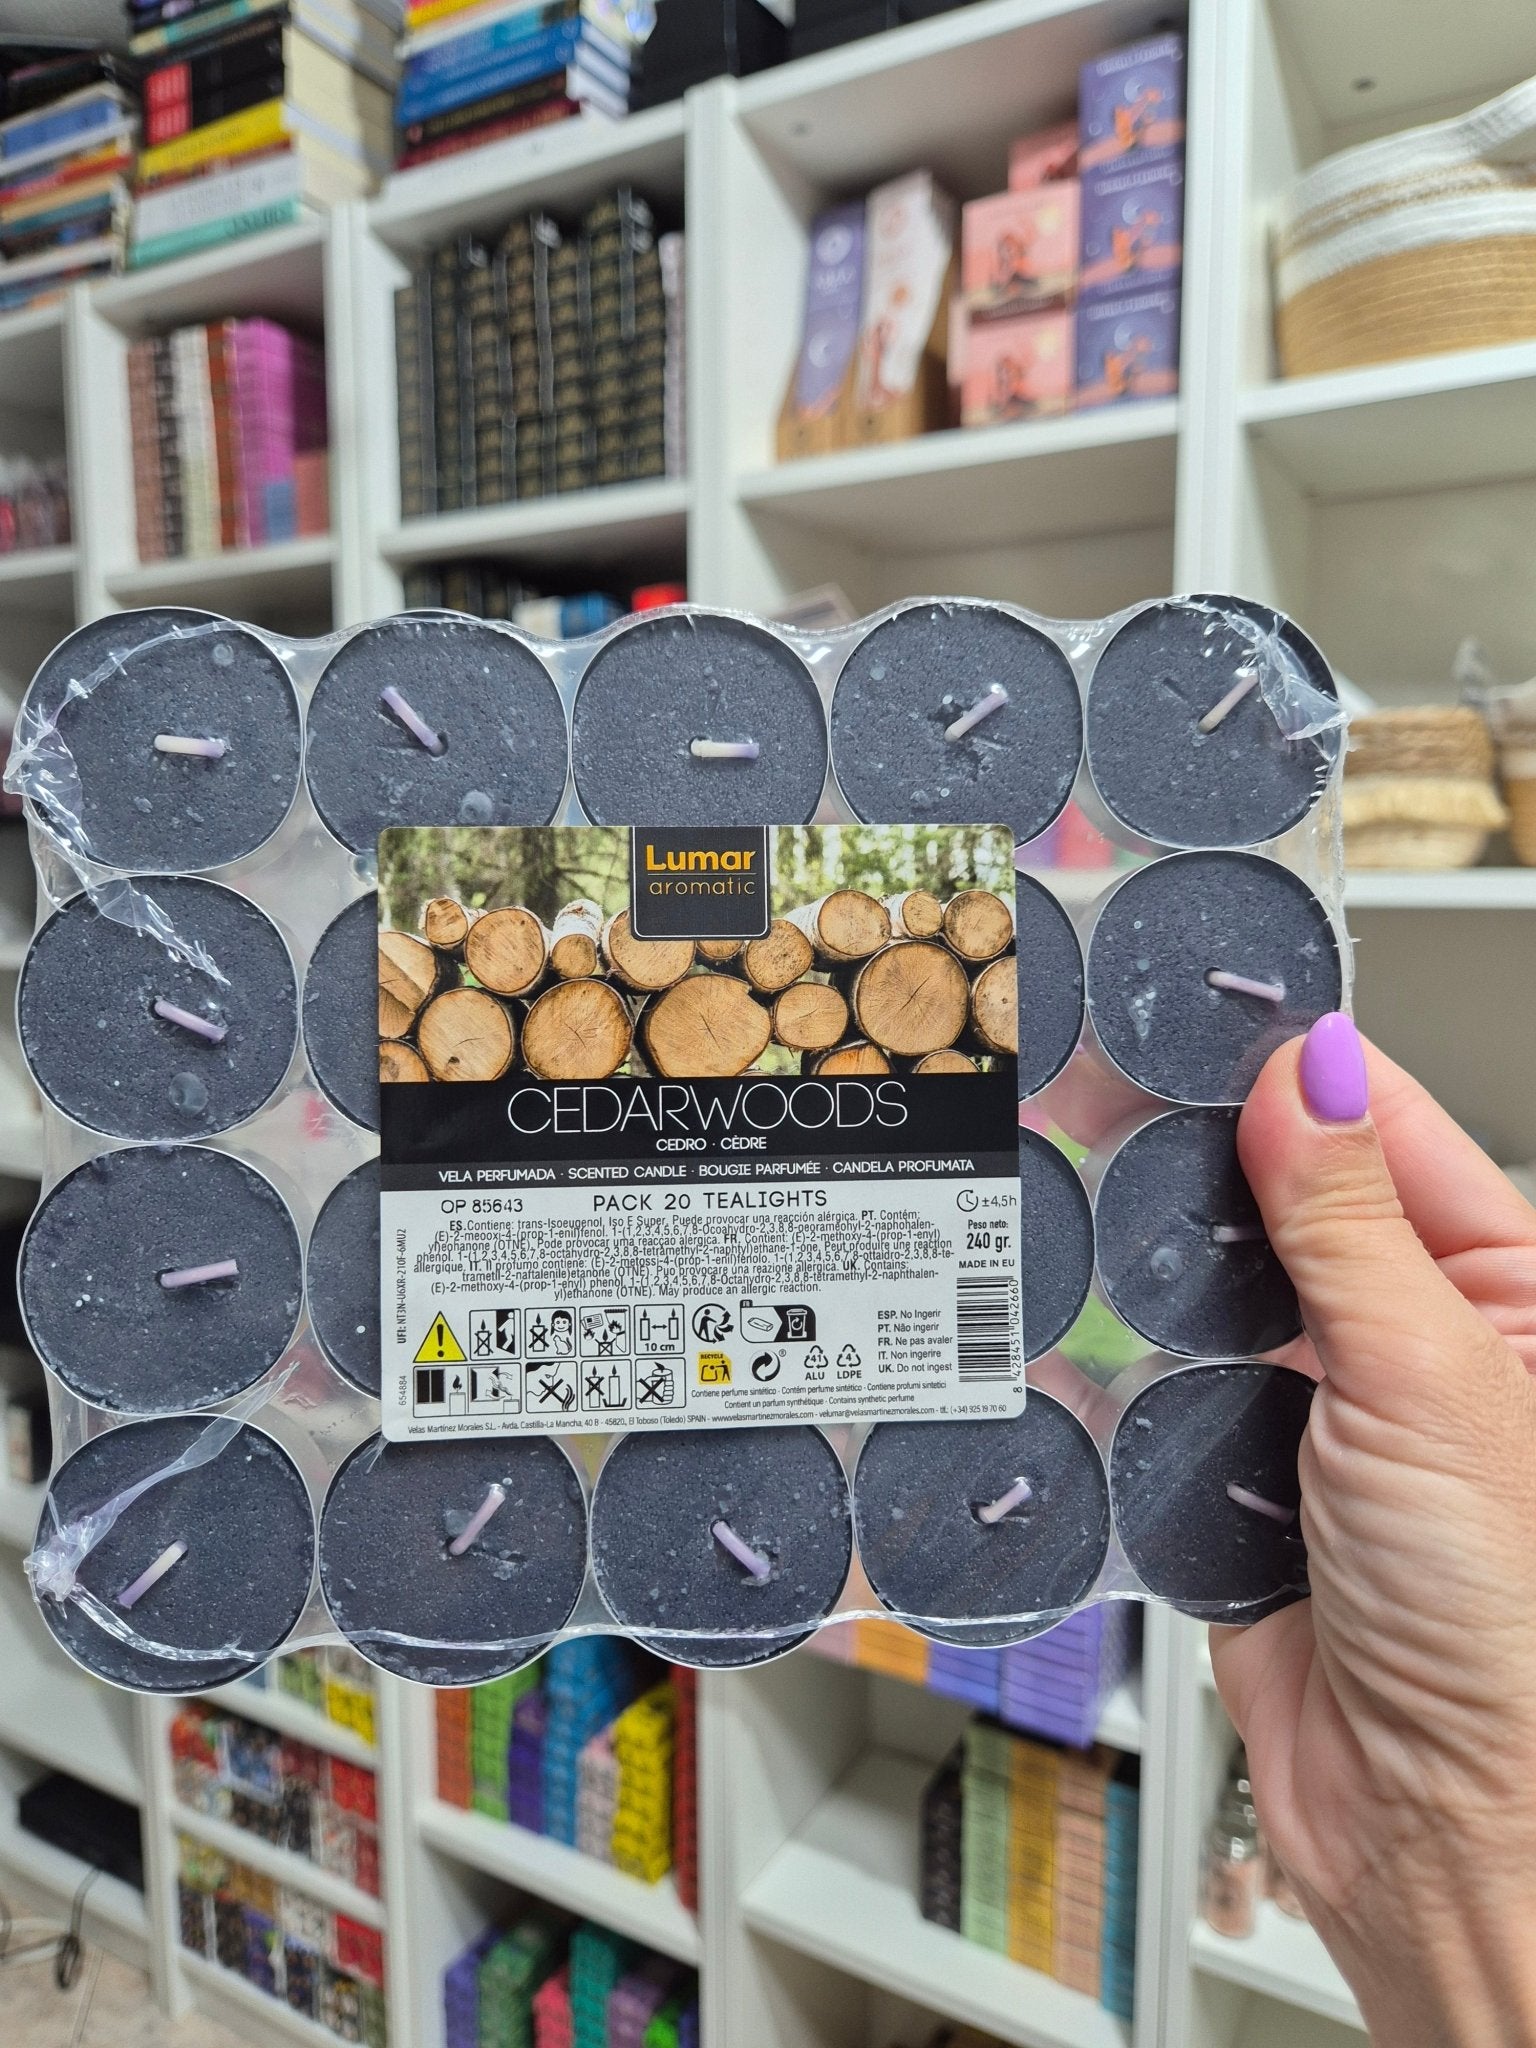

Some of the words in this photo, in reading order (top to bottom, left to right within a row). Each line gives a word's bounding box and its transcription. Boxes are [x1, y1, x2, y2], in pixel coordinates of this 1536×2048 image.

[646, 844, 756, 871] Lumar
[649, 877, 756, 895] aromatic
[508, 1081, 908, 1134] CEDARWOODS
[656, 1138, 707, 1151] CEDRO
[720, 1135, 767, 1150] CÈDRE
[439, 1171, 474, 1184] VELA
[476, 1168, 556, 1182] PERFUMADA
[568, 1166, 629, 1180] SCENTED
[633, 1165, 687, 1178] CANDLE
[699, 1163, 752, 1177] BOUGIE
[755, 1160, 821, 1176] PARFUMÉE
[833, 1160, 895, 1174] CANDELA
[899, 1158, 975, 1172] PROFUMATA
[441, 1199, 467, 1214] OP
[472, 1199, 523, 1213] 85643
[593, 1194, 652, 1212] PACK
[664, 1193, 691, 1210] 20
[703, 1190, 827, 1209] TEALIGHTS
[982, 1194, 1017, 1208] ±4,5h
[609, 1216, 624, 1227] Iso
[627, 1216, 633, 1227] E
[672, 1214, 703, 1226] Puede
[706, 1216, 750, 1227] provocar
[753, 1215, 771, 1224] una
[774, 1212, 815, 1223] reacción
[817, 1211, 858, 1225] alérgica.
[861, 1210, 877, 1221] PT.
[880, 1209, 921, 1221] Contém:
[968, 1220, 987, 1230] Peso
[989, 1220, 1009, 1229] neto:
[537, 1238, 562, 1249] Pode
[566, 1239, 609, 1251] provocar
[613, 1238, 635, 1247] uma
[724, 1233, 741, 1244] FR.
[745, 1232, 788, 1243] Contient:
[825, 1240, 846, 1251] Peut
[850, 1239, 890, 1253] produire
[893, 1241, 910, 1250] une
[966, 1232, 990, 1249] 240
[995, 1236, 1011, 1252] gr.
[413, 1261, 466, 1275] allergique.
[470, 1260, 482, 1271] IT.
[496, 1259, 539, 1273] profumo
[542, 1258, 587, 1269] contiene:
[679, 1267, 728, 1278] provocare
[732, 1266, 749, 1274] una
[753, 1262, 792, 1273] reazione
[796, 1261, 839, 1275] allergica.
[843, 1260, 860, 1271] UK.
[864, 1259, 908, 1270] Contains:
[959, 1260, 987, 1269] MADE
[989, 1260, 999, 1268] IN
[1002, 1259, 1015, 1268] EU
[659, 1285, 680, 1299] May
[683, 1284, 723, 1298] produce
[726, 1286, 738, 1294] an
[741, 1282, 776, 1296] allergic
[780, 1281, 821, 1292] reaction.
[1009, 1280, 1019, 1324] 042660
[877, 1310, 898, 1320] ESP.
[900, 1310, 912, 1319] No
[915, 1309, 941, 1321] Ingerir
[397, 1325, 406, 1344] UFI:
[877, 1324, 891, 1332] PT.
[893, 1323, 910, 1332] Não
[913, 1322, 940, 1334] ingerir
[644, 1343, 659, 1351] 10
[878, 1337, 893, 1346] FR.
[895, 1337, 908, 1346] Ne
[910, 1338, 925, 1348] pas
[927, 1336, 953, 1345] avaler
[811, 1355, 822, 1363] 41
[845, 1353, 852, 1361] 4
[878, 1351, 889, 1360] IT.
[891, 1351, 908, 1359] Non
[910, 1349, 942, 1361] ingerire
[1011, 1332, 1021, 1377] 428451
[805, 1372, 825, 1380] ALU
[837, 1370, 862, 1379] LDPE
[878, 1364, 894, 1373] UK.
[897, 1364, 908, 1373] Do
[910, 1364, 924, 1372] not
[927, 1363, 952, 1374] ingest
[399, 1375, 407, 1406] 654884
[691, 1389, 720, 1398] Contiene
[721, 1389, 748, 1398] perfume
[808, 1385, 834, 1395] perfume
[867, 1383, 895, 1391] Contiene
[897, 1381, 920, 1390] profumi
[922, 1381, 946, 1389] sintetici
[725, 1400, 751, 1409] Contient
[763, 1399, 785, 1408] parfum
[829, 1396, 856, 1404] Contains
[858, 1395, 886, 1405] synthetic
[888, 1394, 914, 1403] perfume
[408, 1425, 426, 1433] Velas
[427, 1423, 456, 1433] Martínez
[458, 1423, 483, 1432] Morales
[636, 1417, 658, 1425] Toboso
[660, 1416, 686, 1425] (Toledo)
[687, 1415, 706, 1423] SPAIN
